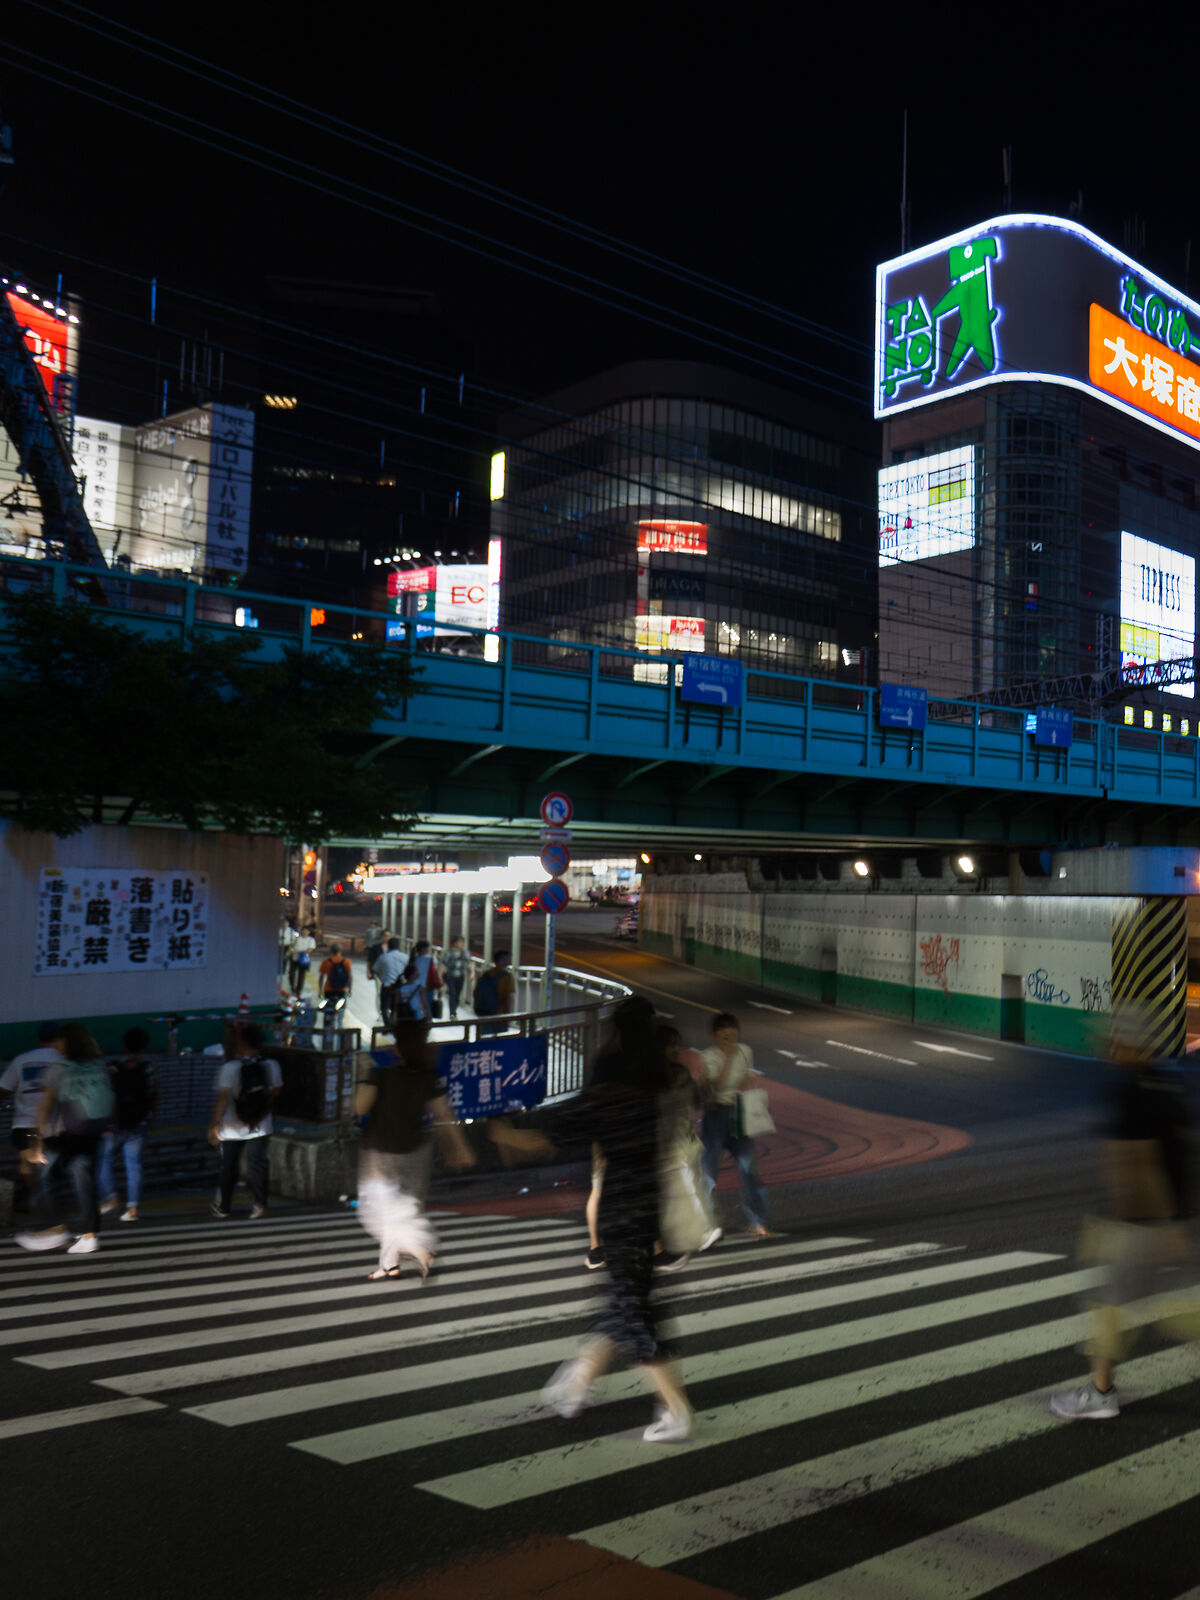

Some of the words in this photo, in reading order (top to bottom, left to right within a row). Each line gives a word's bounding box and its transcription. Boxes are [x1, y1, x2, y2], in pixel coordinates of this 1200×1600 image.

[886, 294, 932, 341] TA
[885, 332, 933, 378] NO
[83, 898, 112, 965] 厳禁
[127, 877, 155, 963] 落書き
[168, 878, 194, 961] 貼り紙
[449, 1050, 505, 1079] 歩行者に
